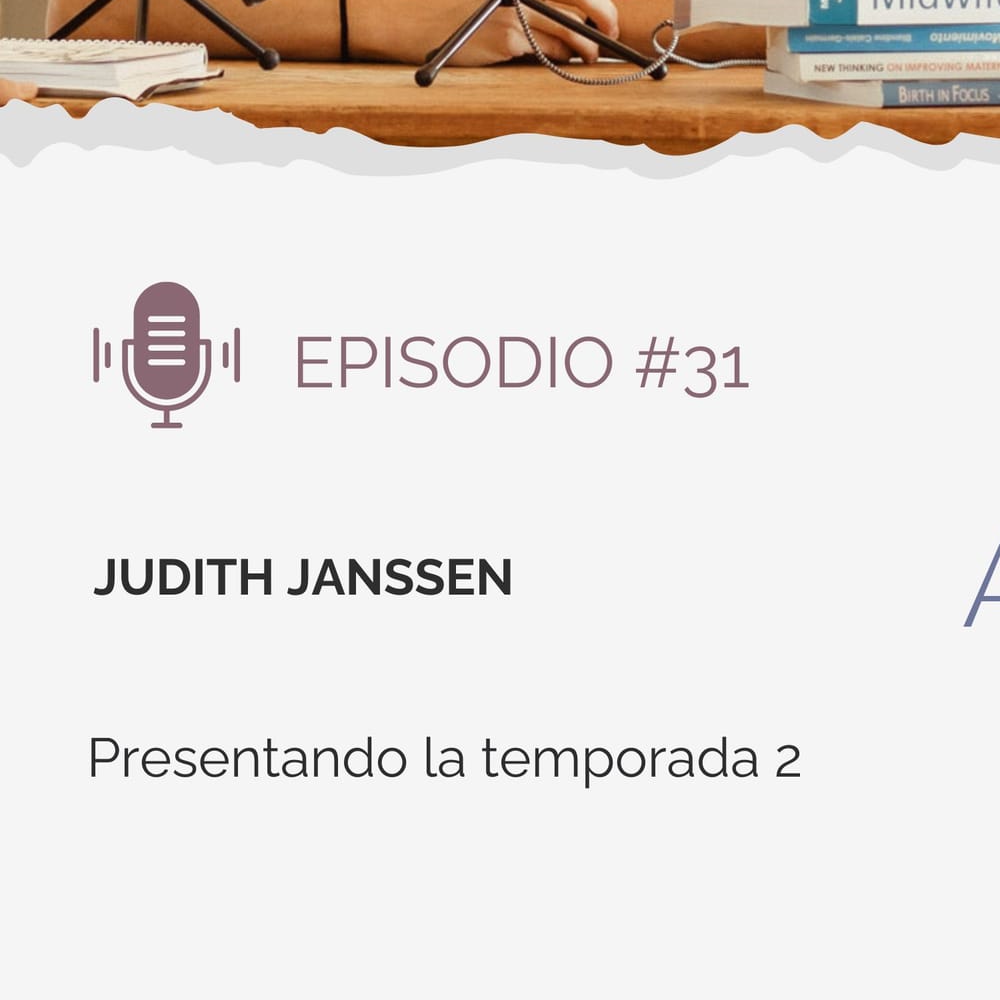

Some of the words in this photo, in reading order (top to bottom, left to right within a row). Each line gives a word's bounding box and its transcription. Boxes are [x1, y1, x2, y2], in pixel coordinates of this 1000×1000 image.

[814, 64, 835, 72] NEW
[838, 63, 884, 72] THINKING
[887, 63, 902, 71] ON
[905, 62, 963, 71] IMPROVING
[938, 88, 949, 102] IN
